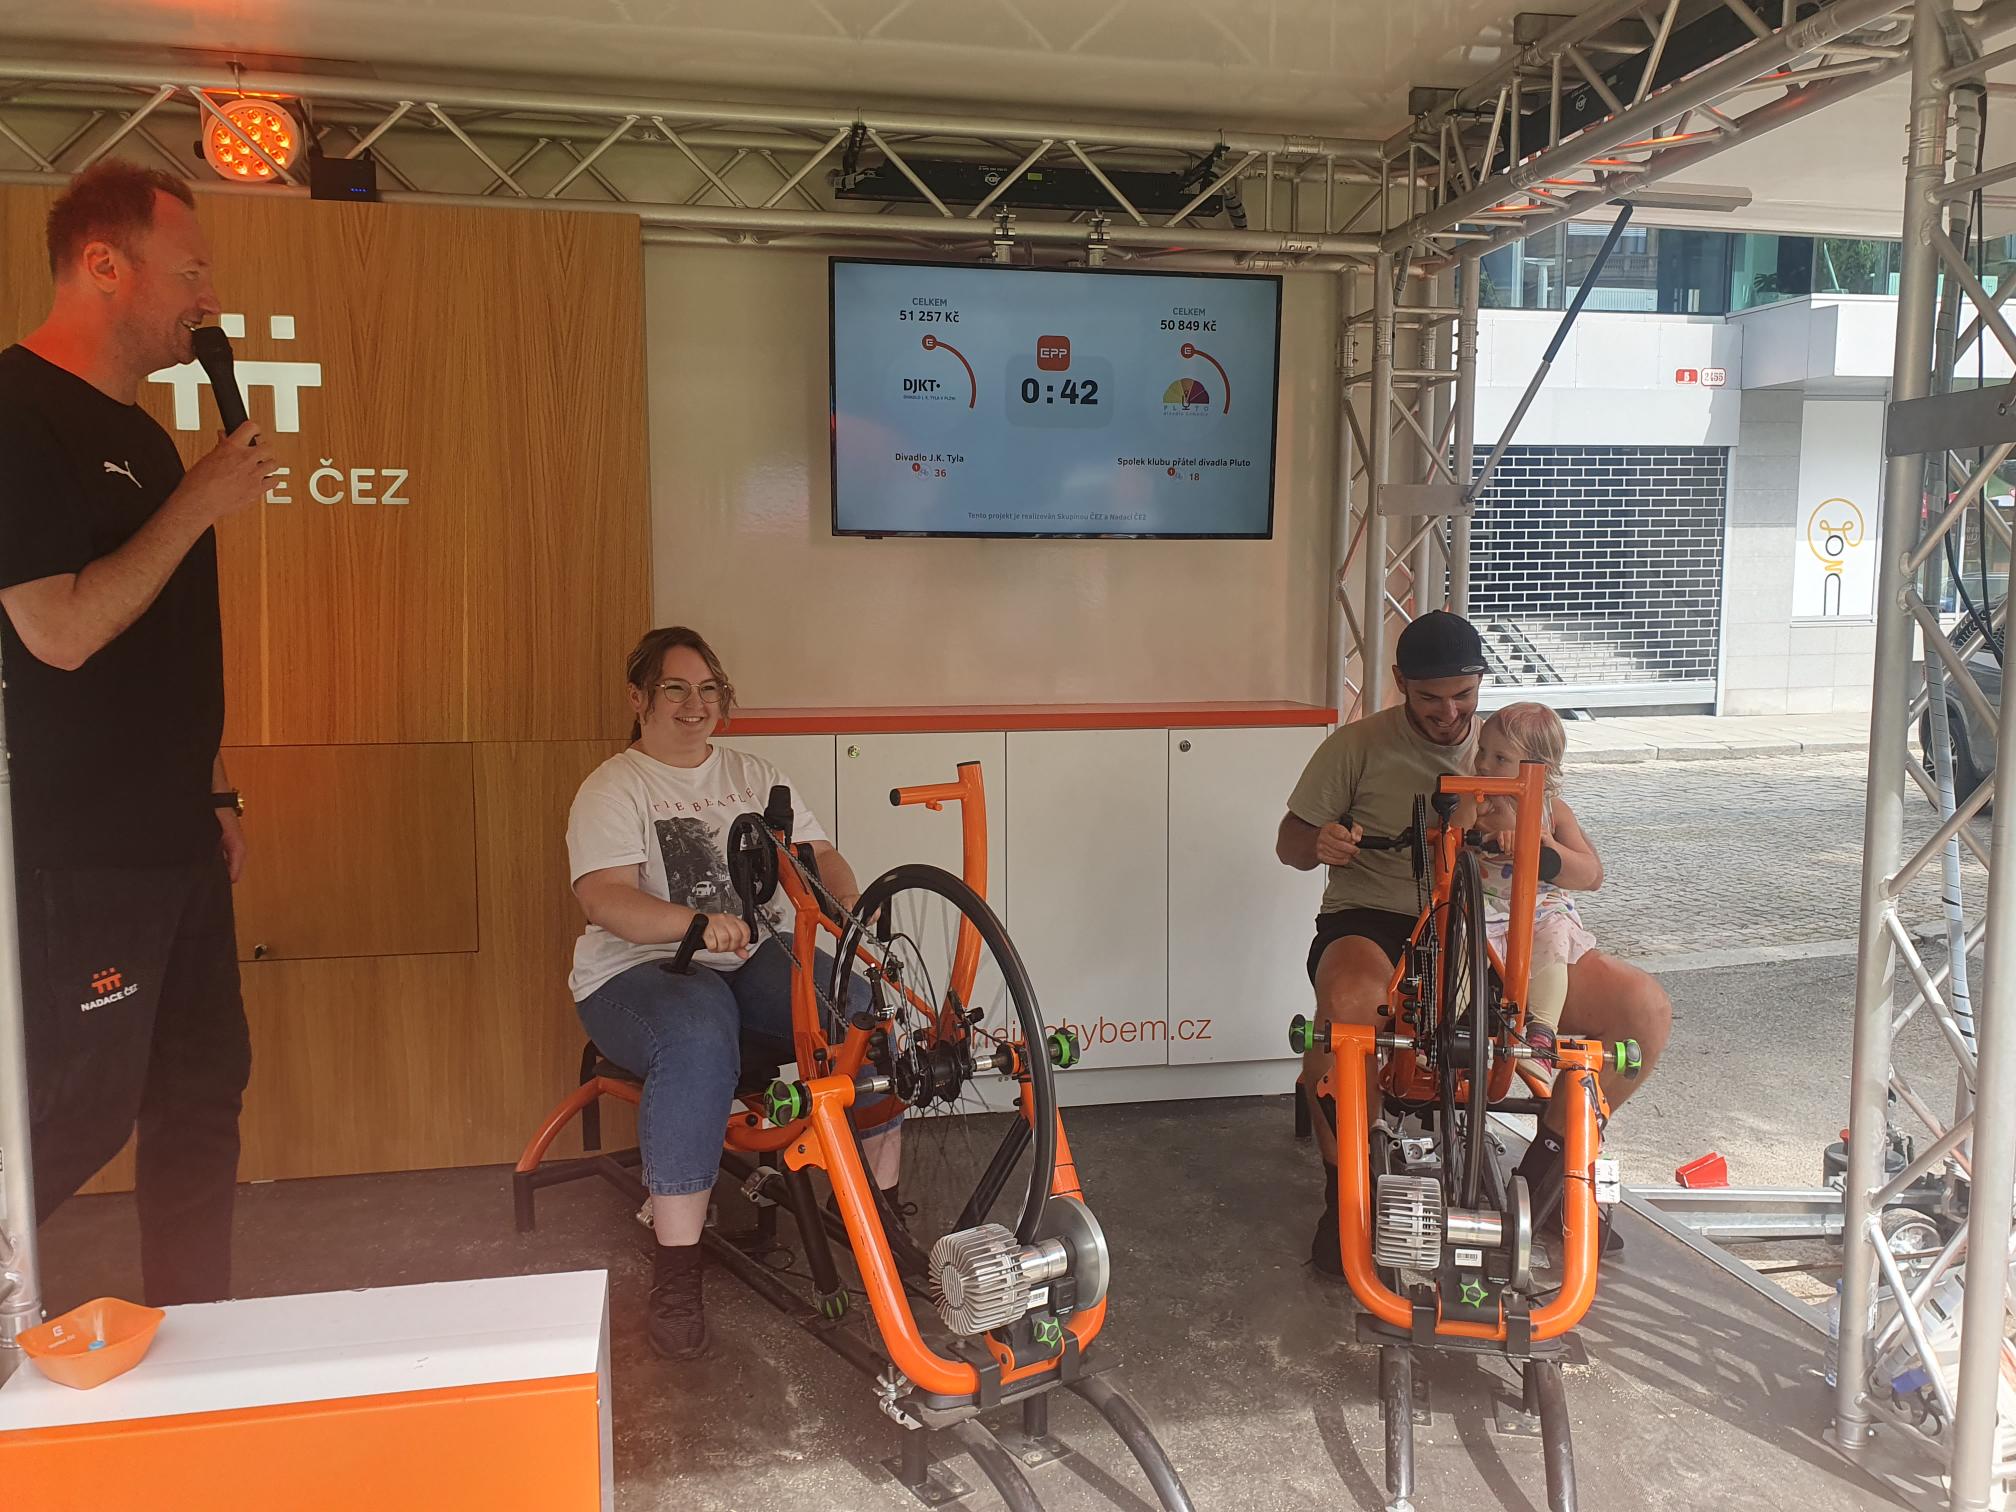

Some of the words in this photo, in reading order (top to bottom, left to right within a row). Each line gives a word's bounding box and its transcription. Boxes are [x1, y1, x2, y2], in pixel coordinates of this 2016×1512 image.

[912, 297, 948, 307] CELKEM
[899, 310, 914, 321] 51
[918, 311, 942, 322] 257
[945, 310, 960, 323] Kč
[1172, 307, 1206, 317] CELKEM
[1160, 319, 1175, 331] 50
[1177, 320, 1200, 332] 849
[1203, 320, 1217, 332] Kč
[1040, 347, 1068, 359] EPP
[1021, 378, 1099, 405] 0:42
[895, 453, 927, 462] Divadlo
[947, 454, 964, 464] Tyla
[1117, 457, 1145, 466] Spolek
[1147, 458, 1171, 467] klubu
[1198, 458, 1228, 467] divadla
[1229, 459, 1251, 467] Pluto
[934, 468, 947, 478] 36
[1189, 473, 1200, 481] 18
[309, 458, 410, 505] ČEZ
[968, 512, 986, 520] Tento
[988, 512, 1012, 521] projekt
[80, 991, 125, 1012] NADACE
